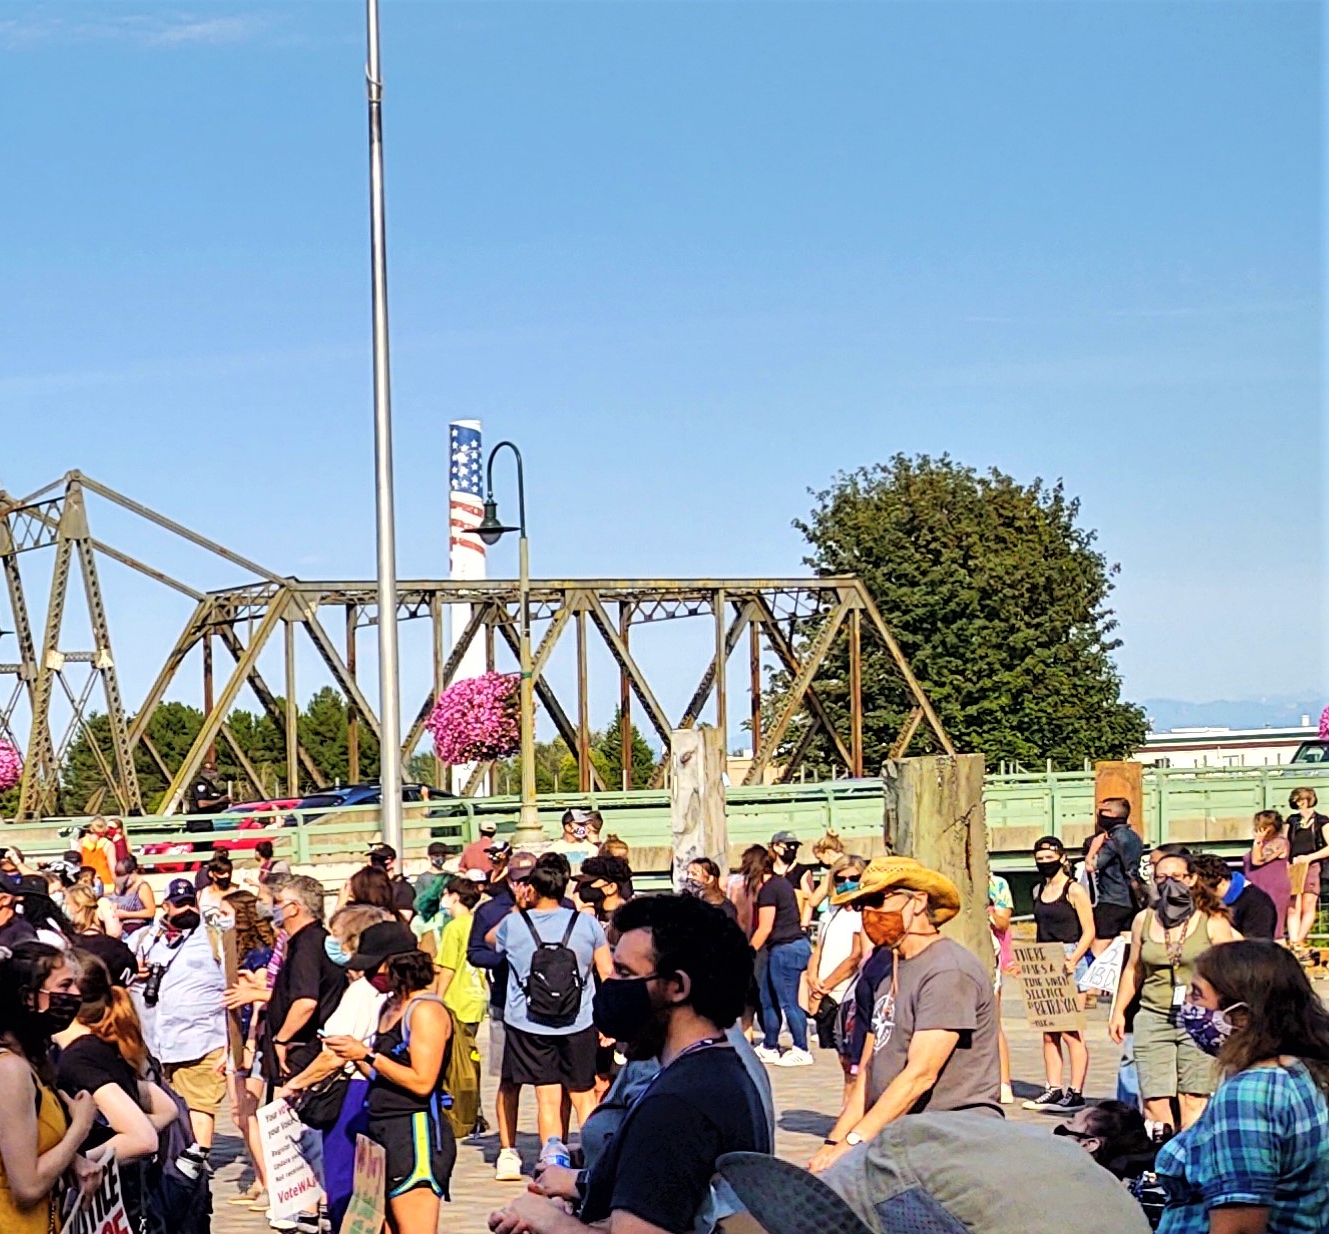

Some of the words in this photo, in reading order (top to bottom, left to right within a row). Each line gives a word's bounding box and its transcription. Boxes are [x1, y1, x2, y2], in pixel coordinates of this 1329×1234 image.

[1014, 947, 1046, 962] THERE
[1049, 963, 1056, 973] A
[1023, 977, 1042, 988] TIME
[1025, 987, 1064, 1000] SILENCE
[1034, 997, 1081, 1016] BETRAYAL
